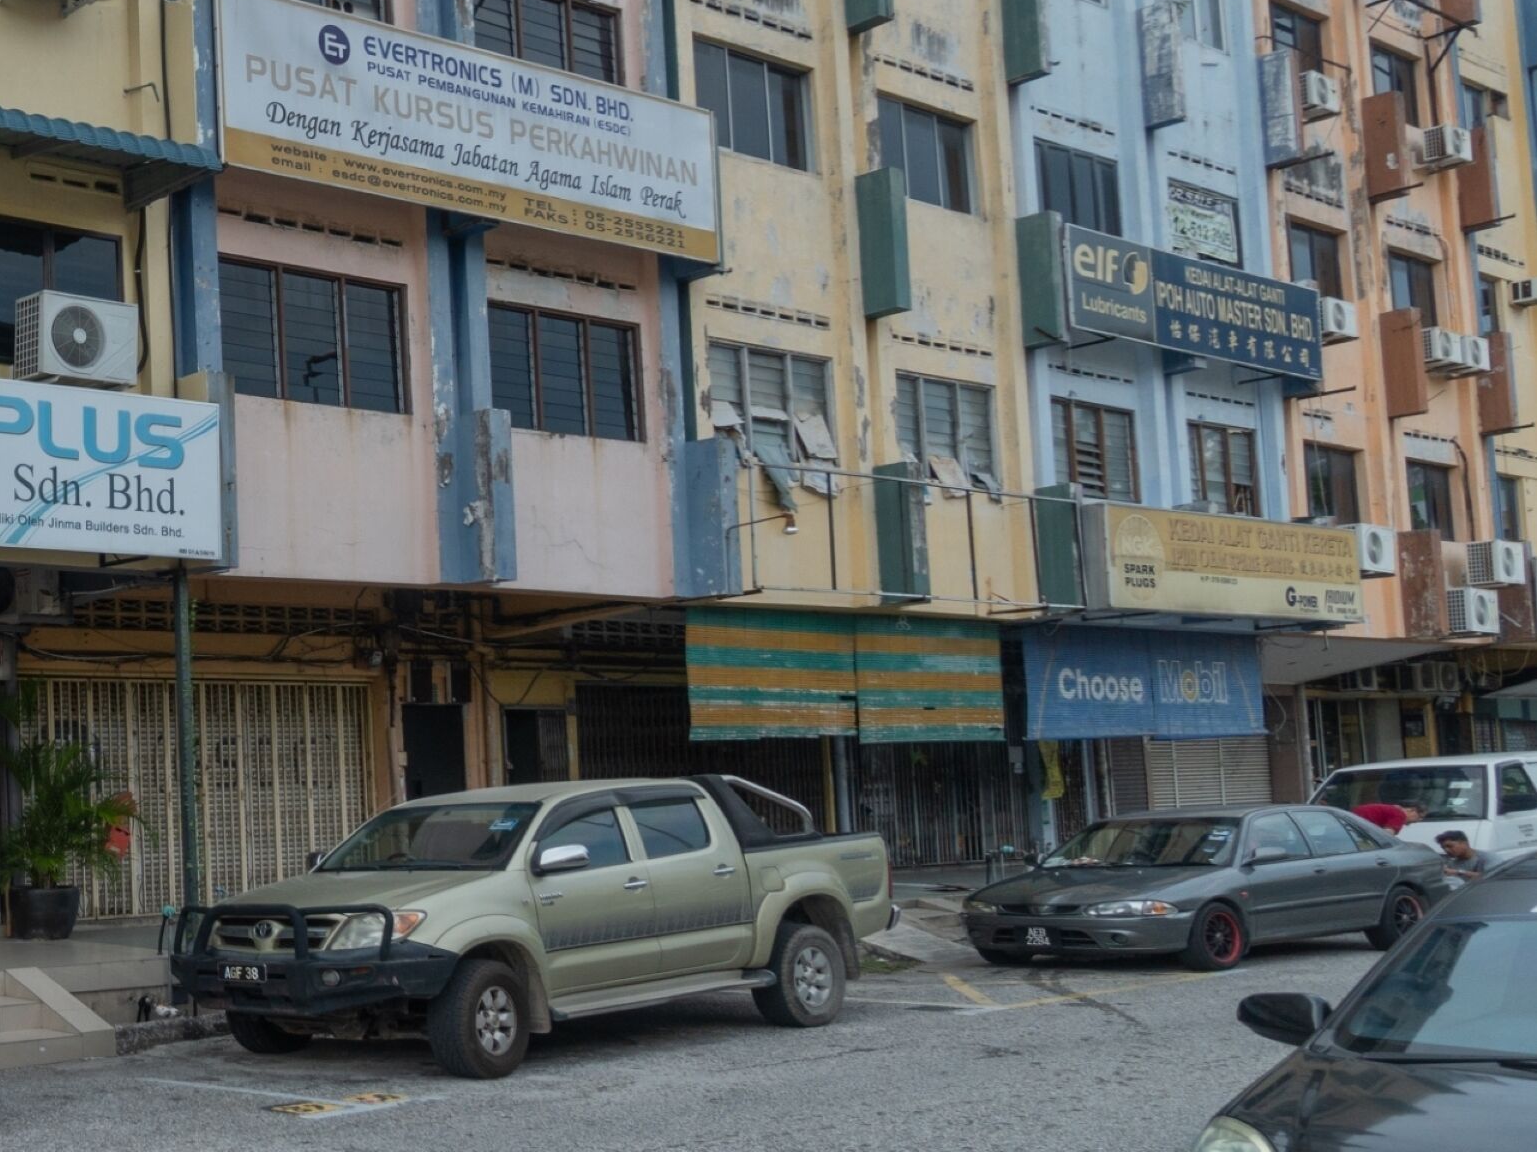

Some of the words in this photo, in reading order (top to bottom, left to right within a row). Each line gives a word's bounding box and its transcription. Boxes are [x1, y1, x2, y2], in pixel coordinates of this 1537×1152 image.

[363, 35, 503, 88] EVERTRONICS
[510, 70, 541, 100] (M)
[550, 85, 591, 112] SDN.
[595, 96, 634, 123] BHD.
[367, 61, 412, 83] PUSAT
[418, 74, 517, 109] PEMBANGUNAN
[521, 99, 591, 128] KEMAHIRAN
[246, 54, 357, 107] PUSAT
[374, 84, 495, 140] KURSUS
[509, 119, 698, 187] PERKAHWINAN
[265, 101, 342, 142] Dengan
[351, 121, 445, 160] Kerjasama
[450, 142, 520, 178] Jabatan
[524, 159, 582, 191] Agama
[590, 175, 632, 203] Islam
[639, 186, 687, 219] Perak
[270, 142, 327, 162] website
[343, 156, 507, 201] www.evertronics.com.my
[271, 155, 312, 173] email
[523, 206, 569, 225] FAKS
[524, 197, 557, 213] TEL
[1073, 242, 1119, 284] elf
[1081, 293, 1148, 324] Lubricants
[1154, 281, 1184, 312] IPOH
[1185, 288, 1215, 320] AUTO
[1217, 296, 1263, 331] MASTER
[1264, 307, 1289, 336] SDN.
[1290, 313, 1316, 343] BHD.
[12, 463, 91, 508] Sdn.
[106, 466, 186, 518] Bhd.
[17, 514, 44, 528] Oleh
[48, 517, 82, 530] Jinma
[85, 520, 129, 534] Builders
[133, 524, 158, 536] Sdn.
[161, 526, 185, 538] Bhd.
[1124, 563, 1155, 576] SPARK
[1124, 577, 1156, 589] PLUGS
[1058, 667, 1144, 702] Choose
[1157, 659, 1229, 705] Mobil
[223, 966, 243, 980] AGF
[244, 966, 259, 980] 38
